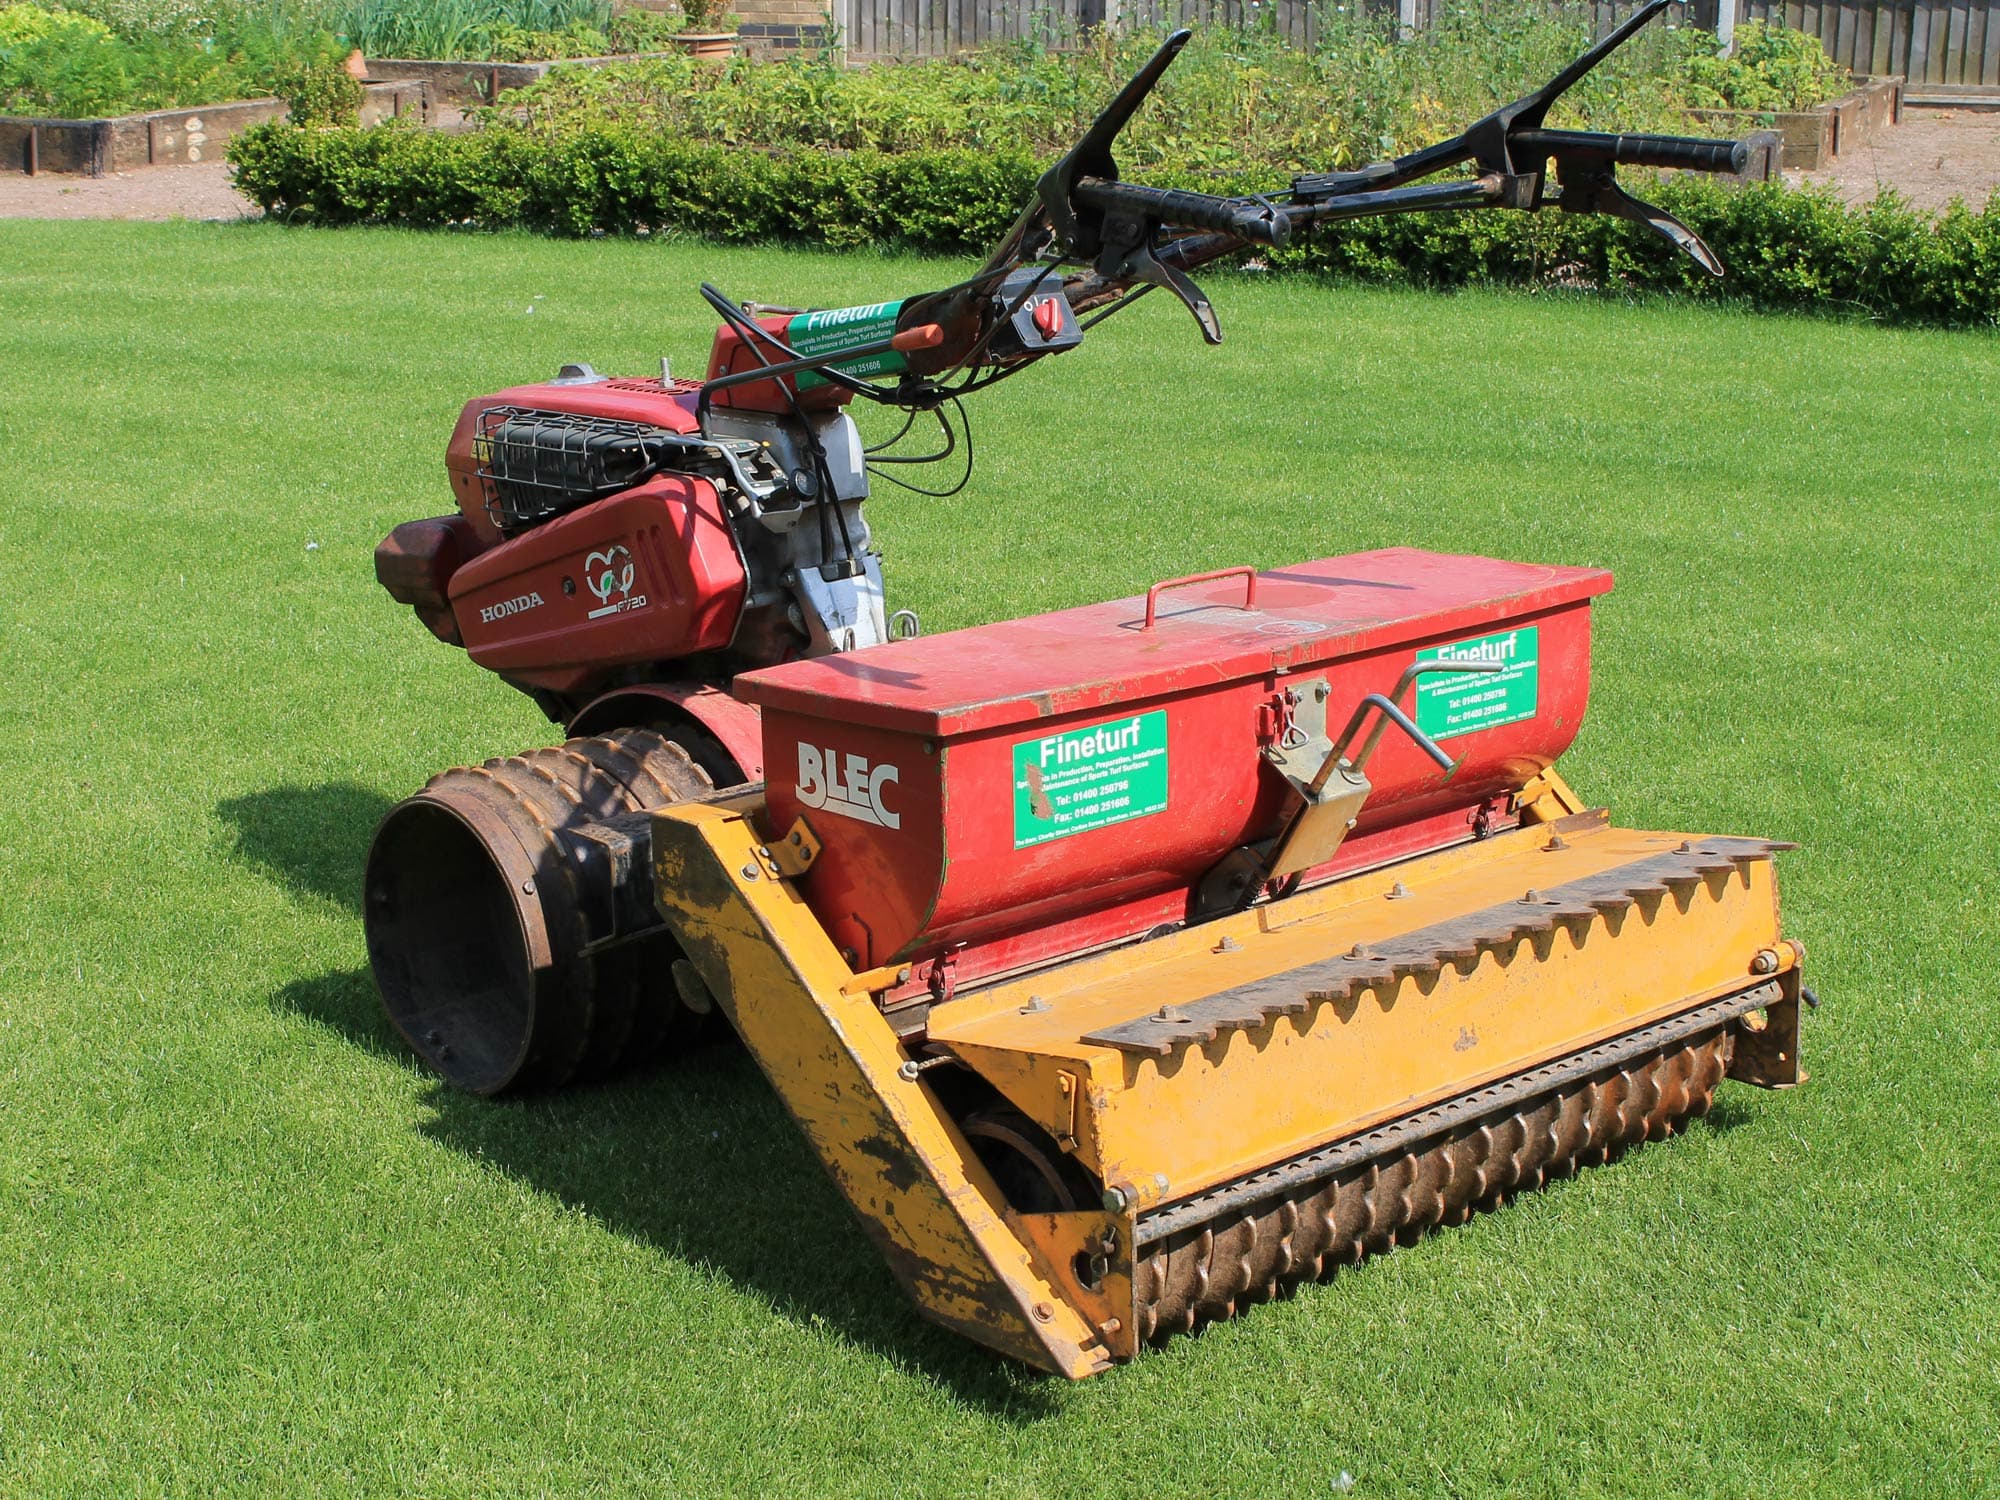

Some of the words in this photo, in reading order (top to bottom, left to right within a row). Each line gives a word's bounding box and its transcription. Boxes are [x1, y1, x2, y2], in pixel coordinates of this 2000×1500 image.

[479, 591, 545, 624] HONDA
[1437, 631, 1518, 661] Fineturf
[1039, 716, 1141, 768] Fineturf
[795, 741, 901, 830] BLEC
[1088, 770, 1108, 783] Sports
[1109, 766, 1122, 777] Turf
[1054, 812, 1073, 825] Fax:
[1074, 803, 1100, 819] 01400
[1100, 796, 1130, 812] 251606
[1055, 794, 1072, 807] Tel:
[1072, 787, 1099, 802] 01400
